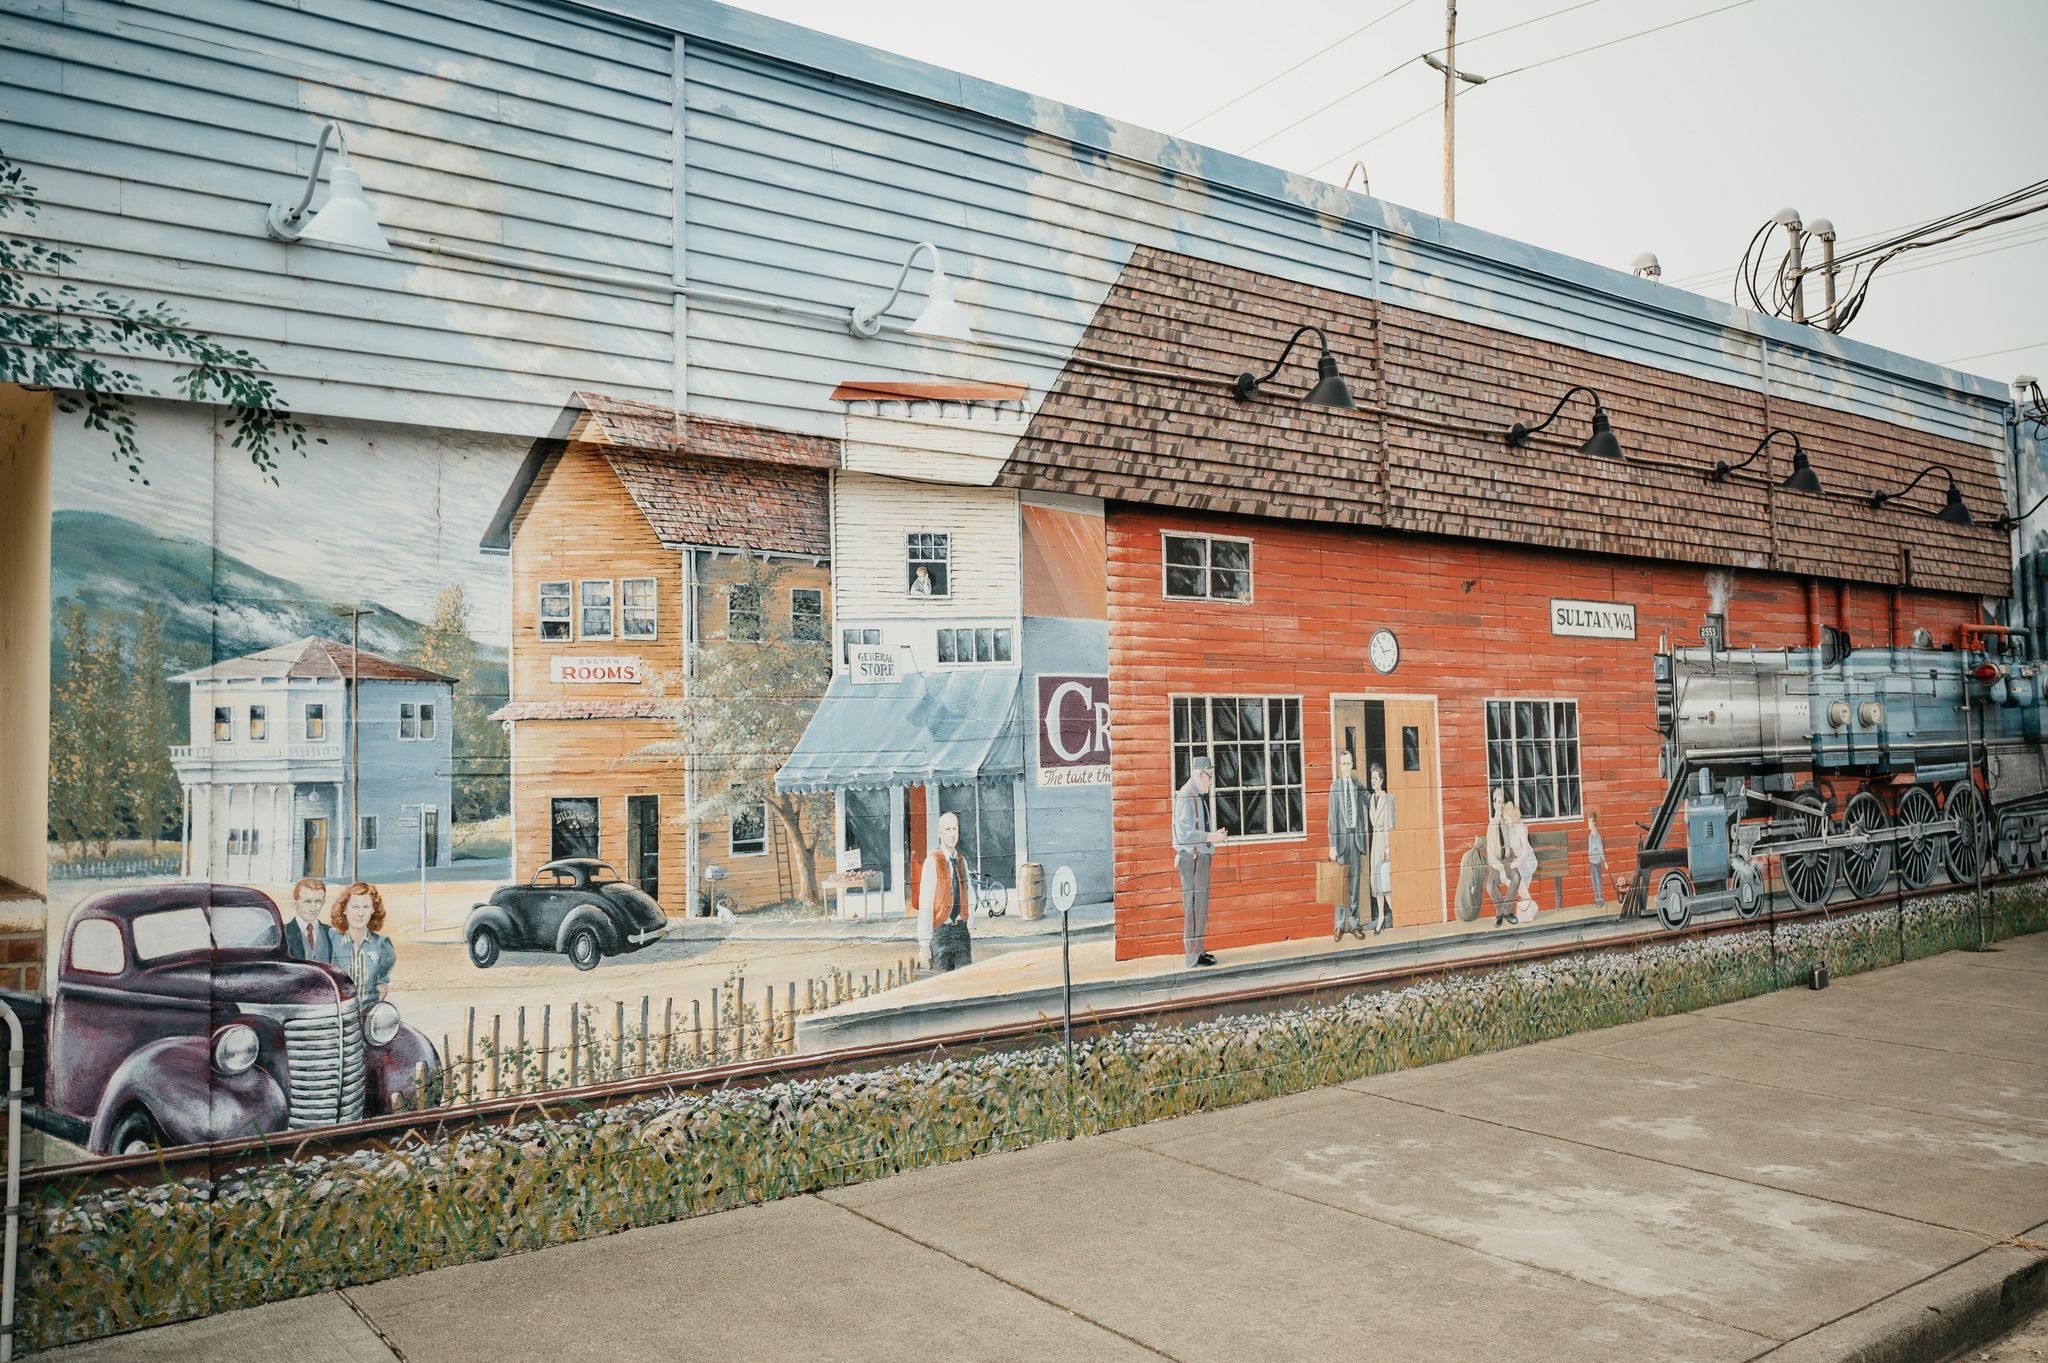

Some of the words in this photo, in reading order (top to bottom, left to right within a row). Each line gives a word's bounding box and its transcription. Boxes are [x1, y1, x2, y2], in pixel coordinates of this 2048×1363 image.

[1701, 627, 1717, 637] 2555
[858, 652, 894, 663] GENERAL
[561, 666, 634, 680] ROOMS
[861, 663, 895, 676] STORE
[1043, 769, 1063, 786] The
[1066, 769, 1093, 785] taste
[1060, 881, 1071, 897] 10
